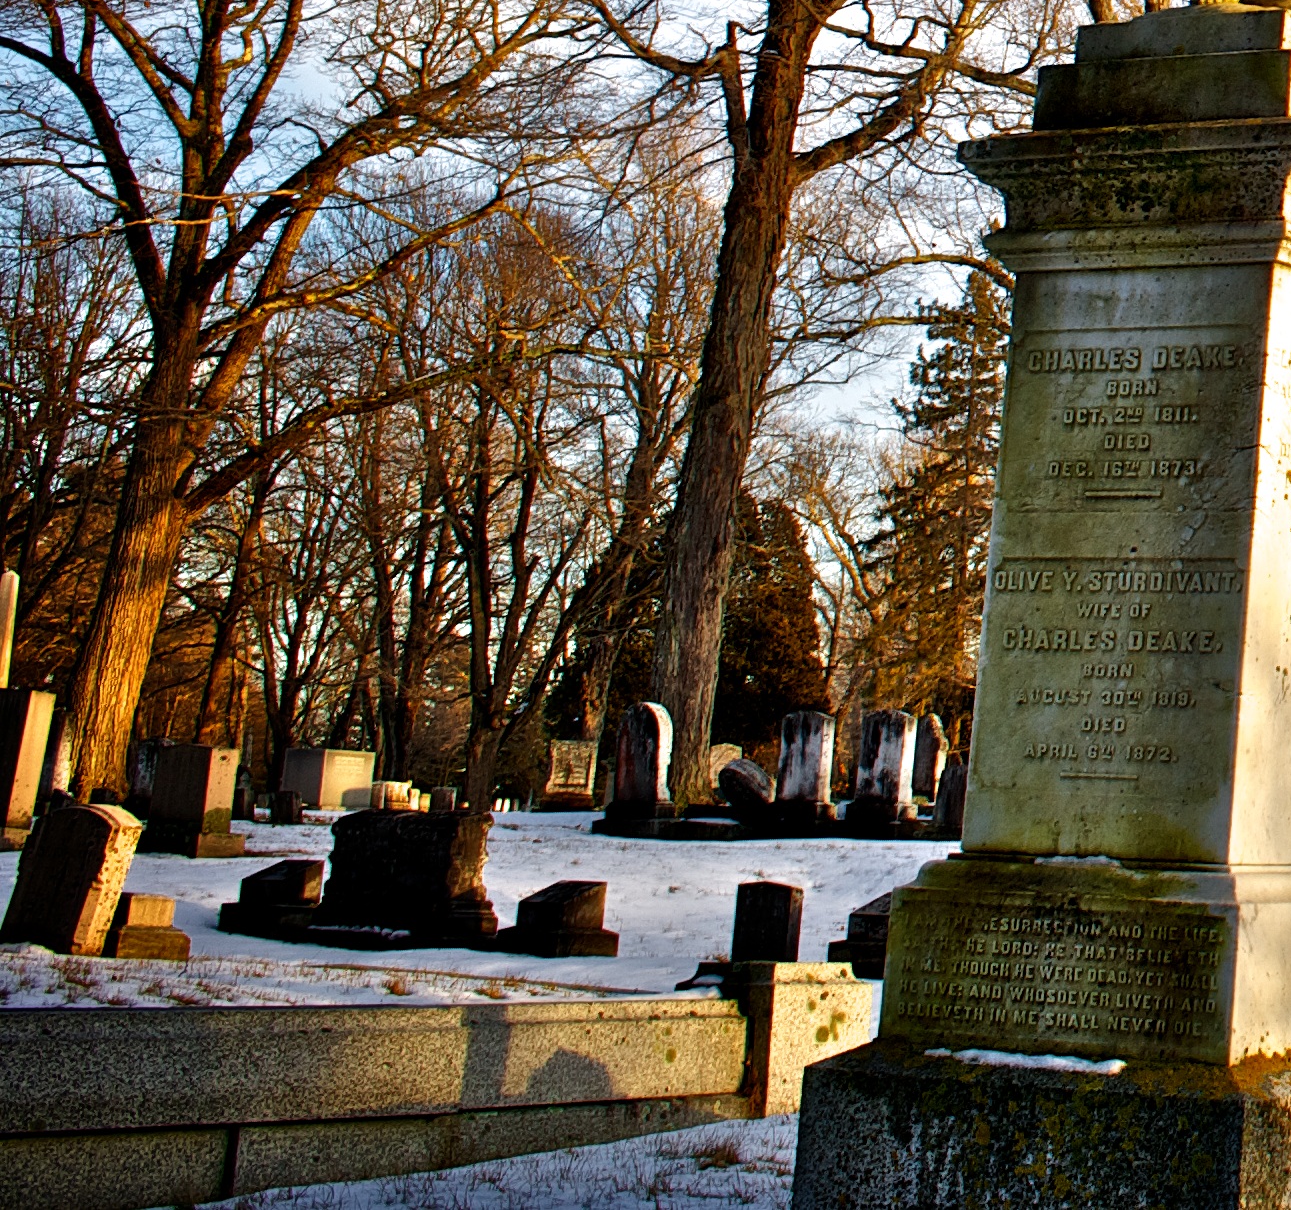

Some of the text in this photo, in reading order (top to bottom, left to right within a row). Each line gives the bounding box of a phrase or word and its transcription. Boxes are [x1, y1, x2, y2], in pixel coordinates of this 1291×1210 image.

[1028, 349, 1140, 373] CHARLES
[1106, 380, 1158, 397] BORN
[1063, 408, 1106, 424] OCT.
[1103, 433, 1151, 450] DIED
[1048, 461, 1094, 477] DEC.
[994, 571, 1053, 592] OLIVE
[1062, 571, 1082, 591] Y.
[1076, 603, 1152, 619] WIFE OF
[1002, 629, 1223, 652] CHARLES DEAKE,
[1083, 664, 1134, 678] BORN
[1081, 716, 1126, 732] DIED
[1024, 742, 1078, 759] APRIL
[1108, 925, 1142, 939] AND
[1149, 926, 1178, 941] THE
[1045, 941, 1066, 958] HE
[1074, 944, 1118, 960] THAT
[951, 961, 1009, 978] THOUGH
[1013, 963, 1034, 979] HE
[1039, 964, 1083, 982] WERE
[1136, 971, 1164, 987] YET
[1171, 973, 1219, 990] SHALL
[900, 979, 917, 994] HE
[968, 983, 1002, 999] AND
[1010, 986, 1110, 1007] WHOSOEVER
[1116, 992, 1174, 1010] LIVETH
[1181, 997, 1216, 1013] AND
[898, 1001, 983, 1021] BELIEVETH
[989, 1008, 1007, 1023] IN
[1013, 1009, 1038, 1025] ME
[1045, 1012, 1099, 1029] SHALL
[1107, 1016, 1166, 1033] NEVER
